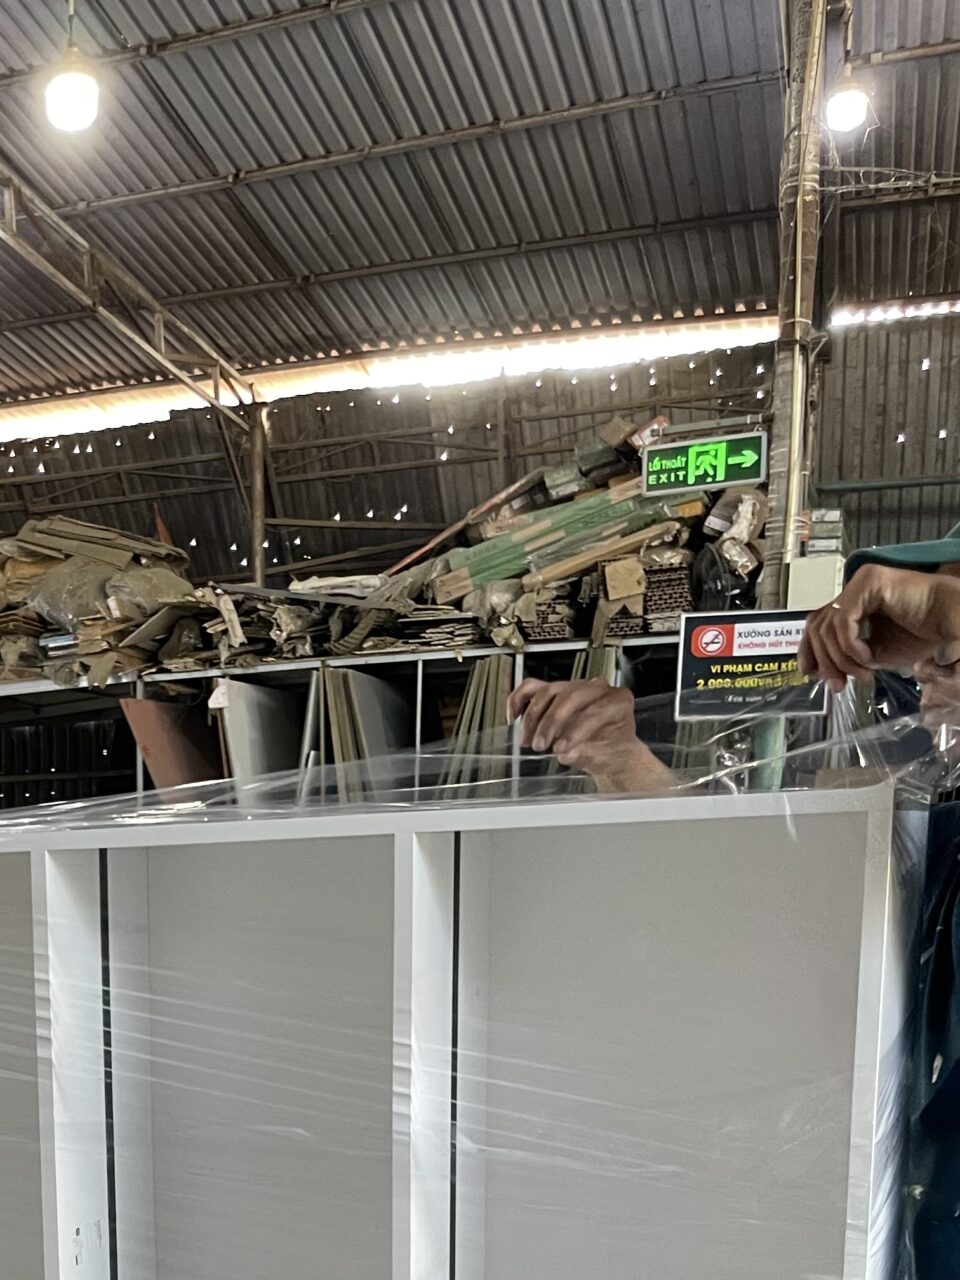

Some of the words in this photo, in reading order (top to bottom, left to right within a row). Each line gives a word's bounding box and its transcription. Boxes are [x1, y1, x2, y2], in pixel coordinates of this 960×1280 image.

[648, 471, 686, 485] EXIT
[710, 665, 721, 673] VI
[723, 663, 752, 674] PHẠM
[754, 662, 778, 672] CAM
